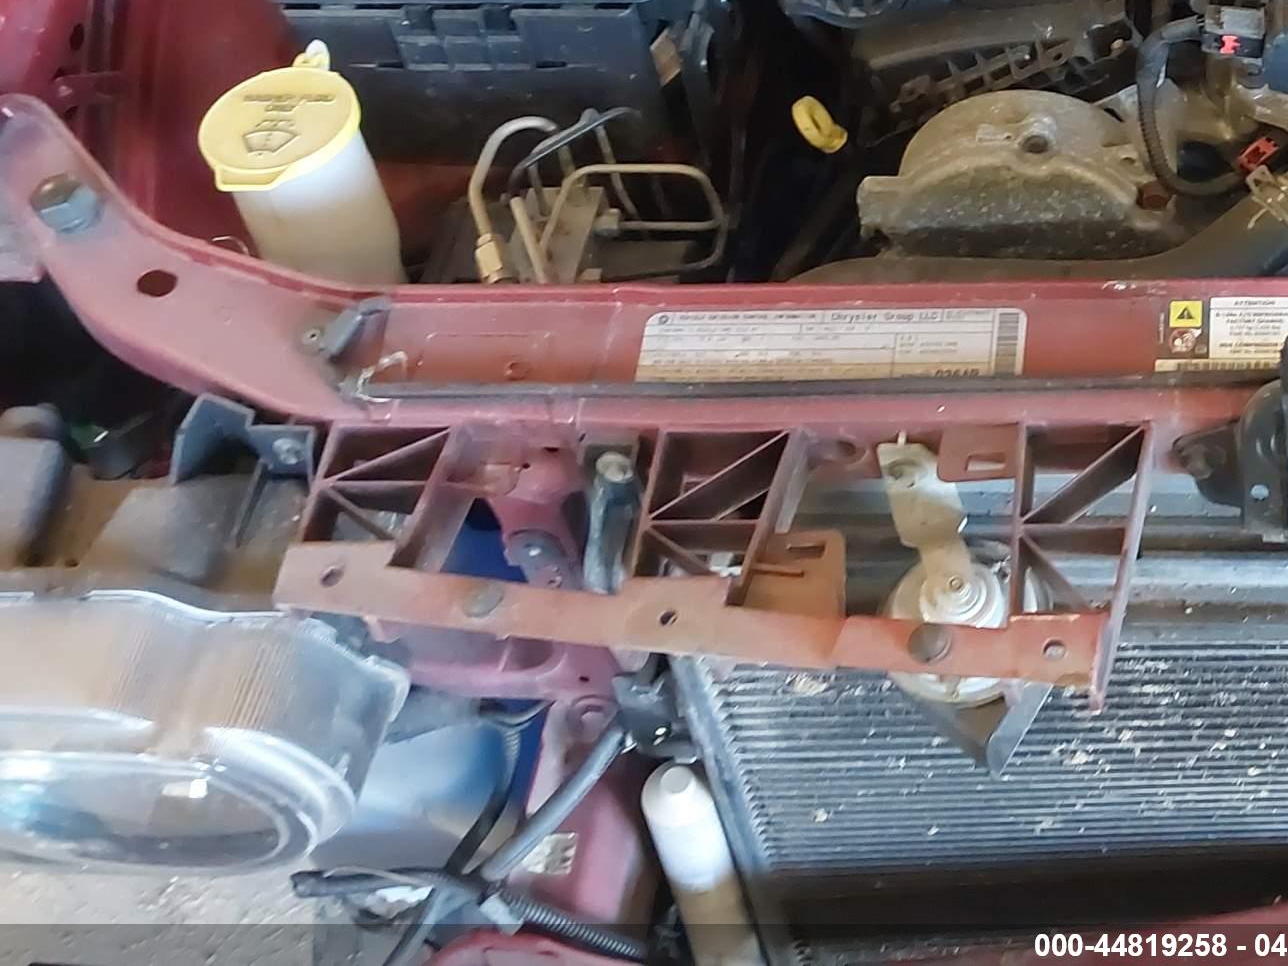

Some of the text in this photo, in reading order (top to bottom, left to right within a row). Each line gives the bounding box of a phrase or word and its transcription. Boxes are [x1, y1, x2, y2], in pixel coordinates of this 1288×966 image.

[831, 312, 878, 323] Chrysler
[884, 312, 914, 322] Group
[919, 312, 939, 320] LLC
